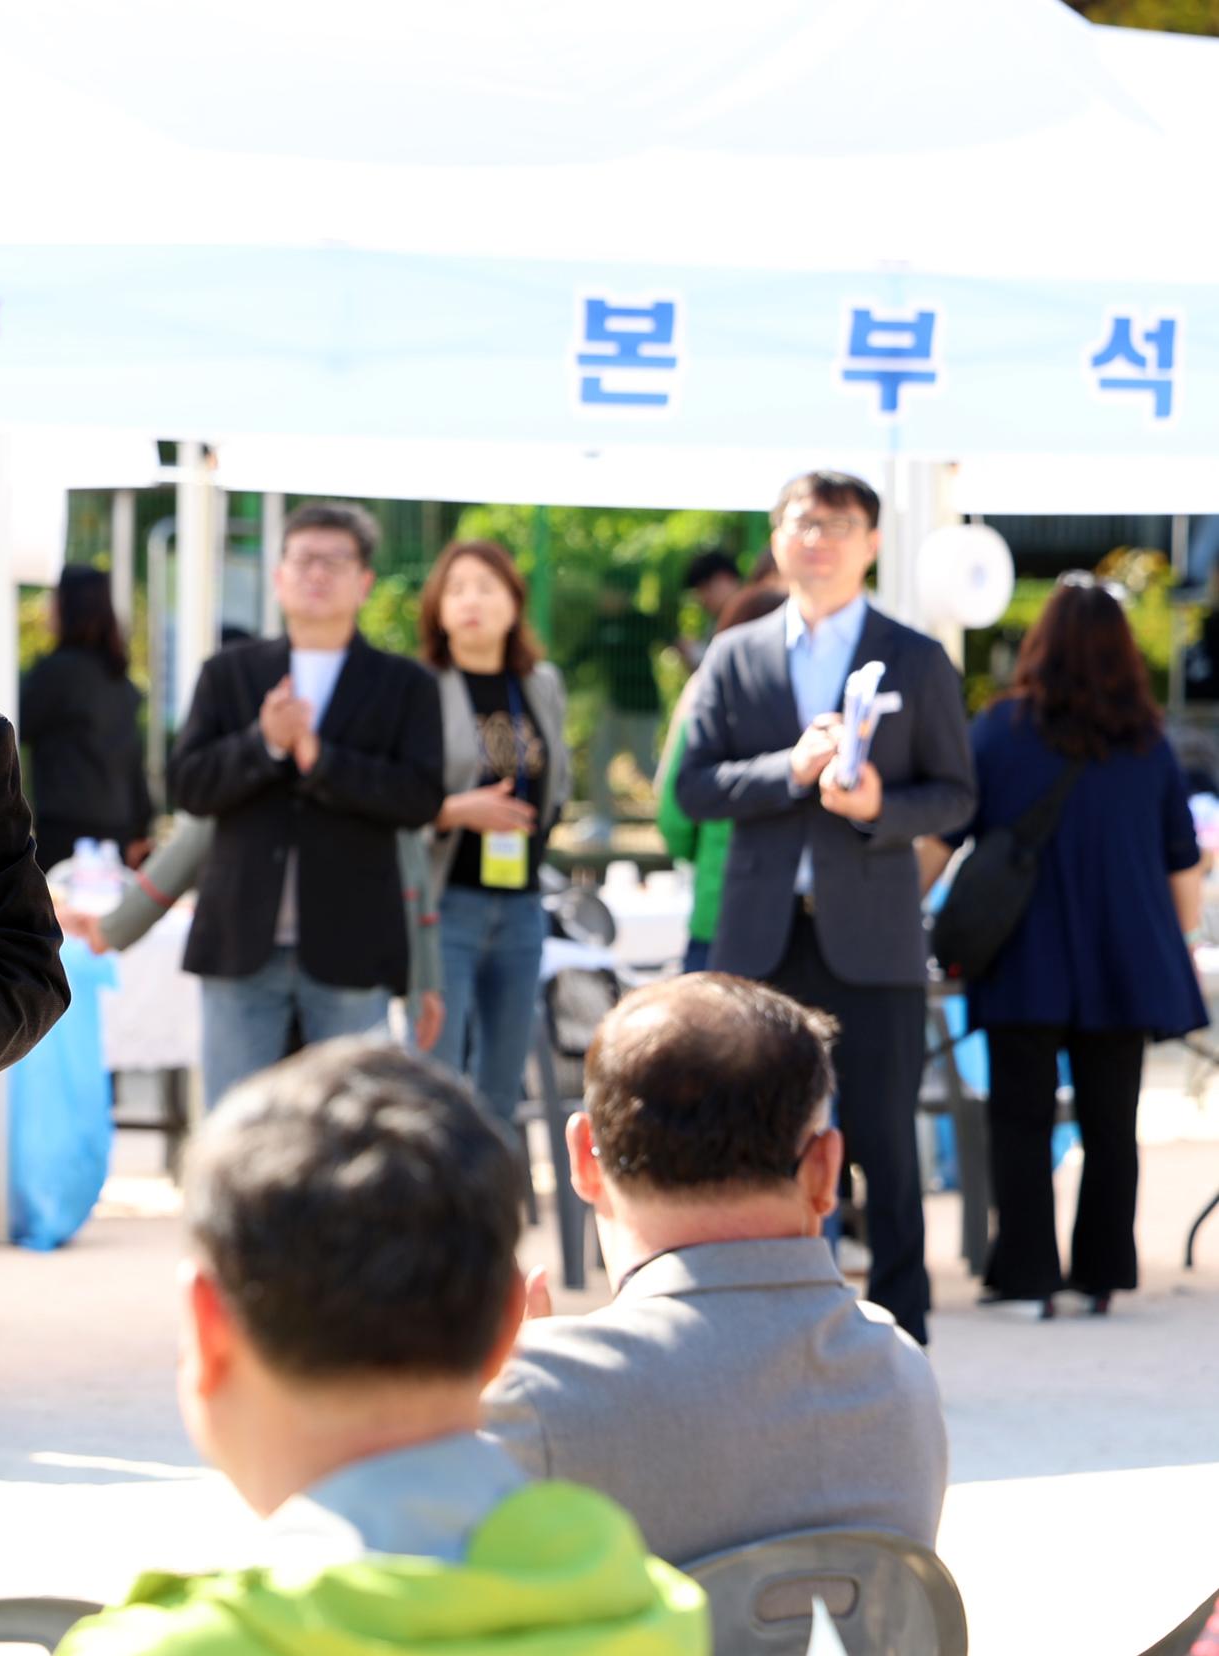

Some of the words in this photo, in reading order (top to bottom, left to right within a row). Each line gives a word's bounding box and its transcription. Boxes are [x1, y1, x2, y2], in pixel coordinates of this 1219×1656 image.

[576, 299, 678, 406] 본
[842, 309, 937, 412] 부
[1092, 318, 1177, 418] 석
